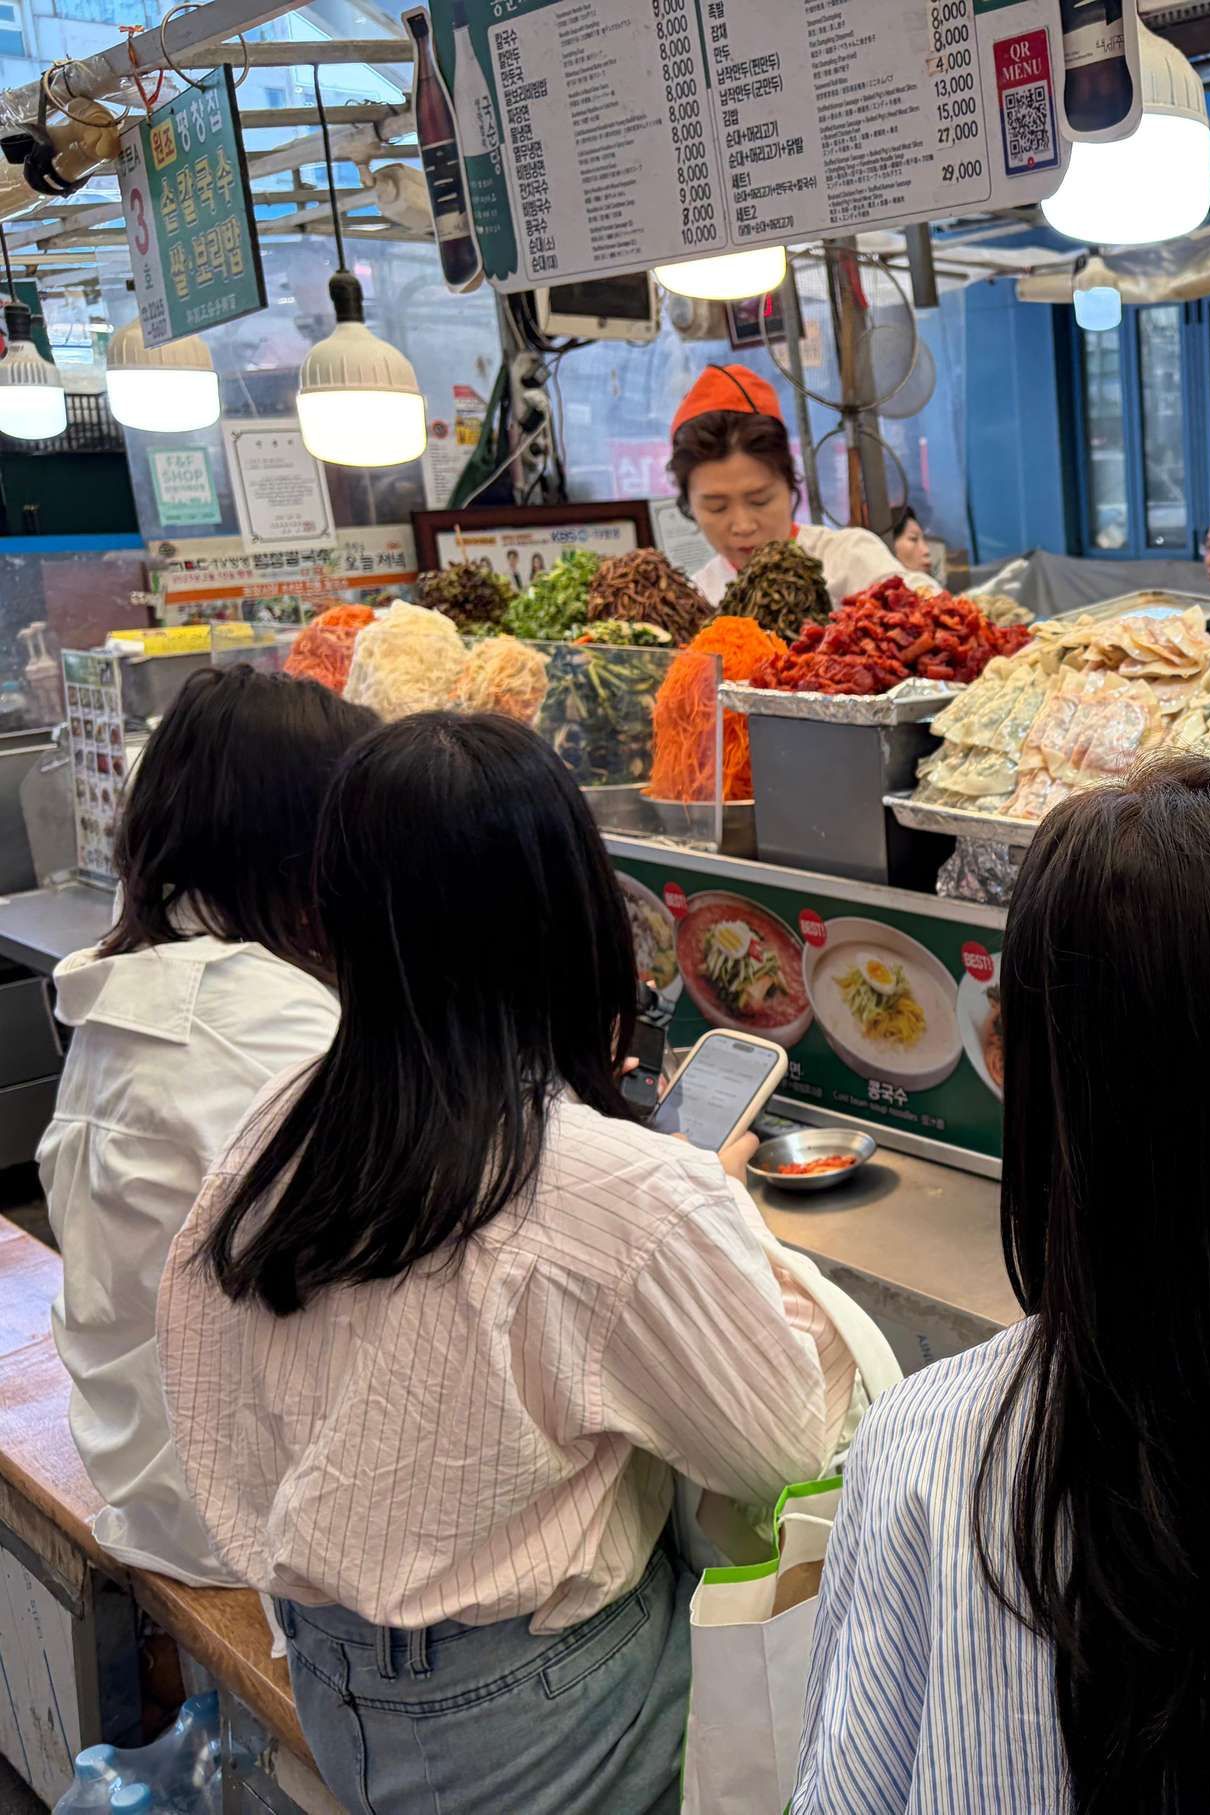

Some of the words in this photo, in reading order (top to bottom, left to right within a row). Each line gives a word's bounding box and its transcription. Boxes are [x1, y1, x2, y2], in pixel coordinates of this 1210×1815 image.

[708, 3, 724, 19] 족발
[931, 0, 966, 29] 8,000
[657, 14, 688, 40] 8,000
[711, 22, 727, 42] 잡채
[660, 36, 691, 60] 8,000
[934, 24, 969, 54] 8,000
[714, 46, 731, 63] 만두
[1010, 41, 1030, 60] QR
[663, 58, 694, 82] 8,000
[936, 49, 971, 75] 4,000
[1002, 58, 1042, 82] MENU
[666, 79, 697, 103] 8,000
[934, 74, 974, 99] 13,000
[669, 100, 700, 124] 8,000
[722, 108, 739, 127] 김밥
[937, 97, 976, 121] 15,000
[151, 129, 175, 164] 원조
[176, 88, 223, 153] 평창집
[672, 121, 703, 144] 8,000
[726, 120, 779, 148] 순대+머리고기
[938, 120, 978, 144] 27,000
[676, 142, 706, 164] 7,000
[728, 136, 804, 169] 순대+머리고기+닭발
[678, 165, 708, 185] 8,000
[731, 171, 751, 190] 세트1
[942, 160, 983, 183] 29,000
[160, 145, 234, 236] 손칼국수
[519, 178, 548, 200] 잔치국수
[680, 184, 711, 205] 9,000
[131, 187, 150, 256] 3
[682, 203, 714, 225] 8,000
[736, 205, 757, 222] 세트2
[681, 224, 717, 246] 10,000
[166, 456, 192, 466] F&F
[162, 469, 203, 481] SHOP
[552, 529, 577, 544] KBS
[346, 554, 374, 572] 오늘
[377, 552, 406, 570] 저녁
[664, 890, 687, 909] BEST!
[801, 920, 826, 938] BEST!
[963, 953, 993, 973] BEST!
[868, 1079, 908, 1107] 콩국수
